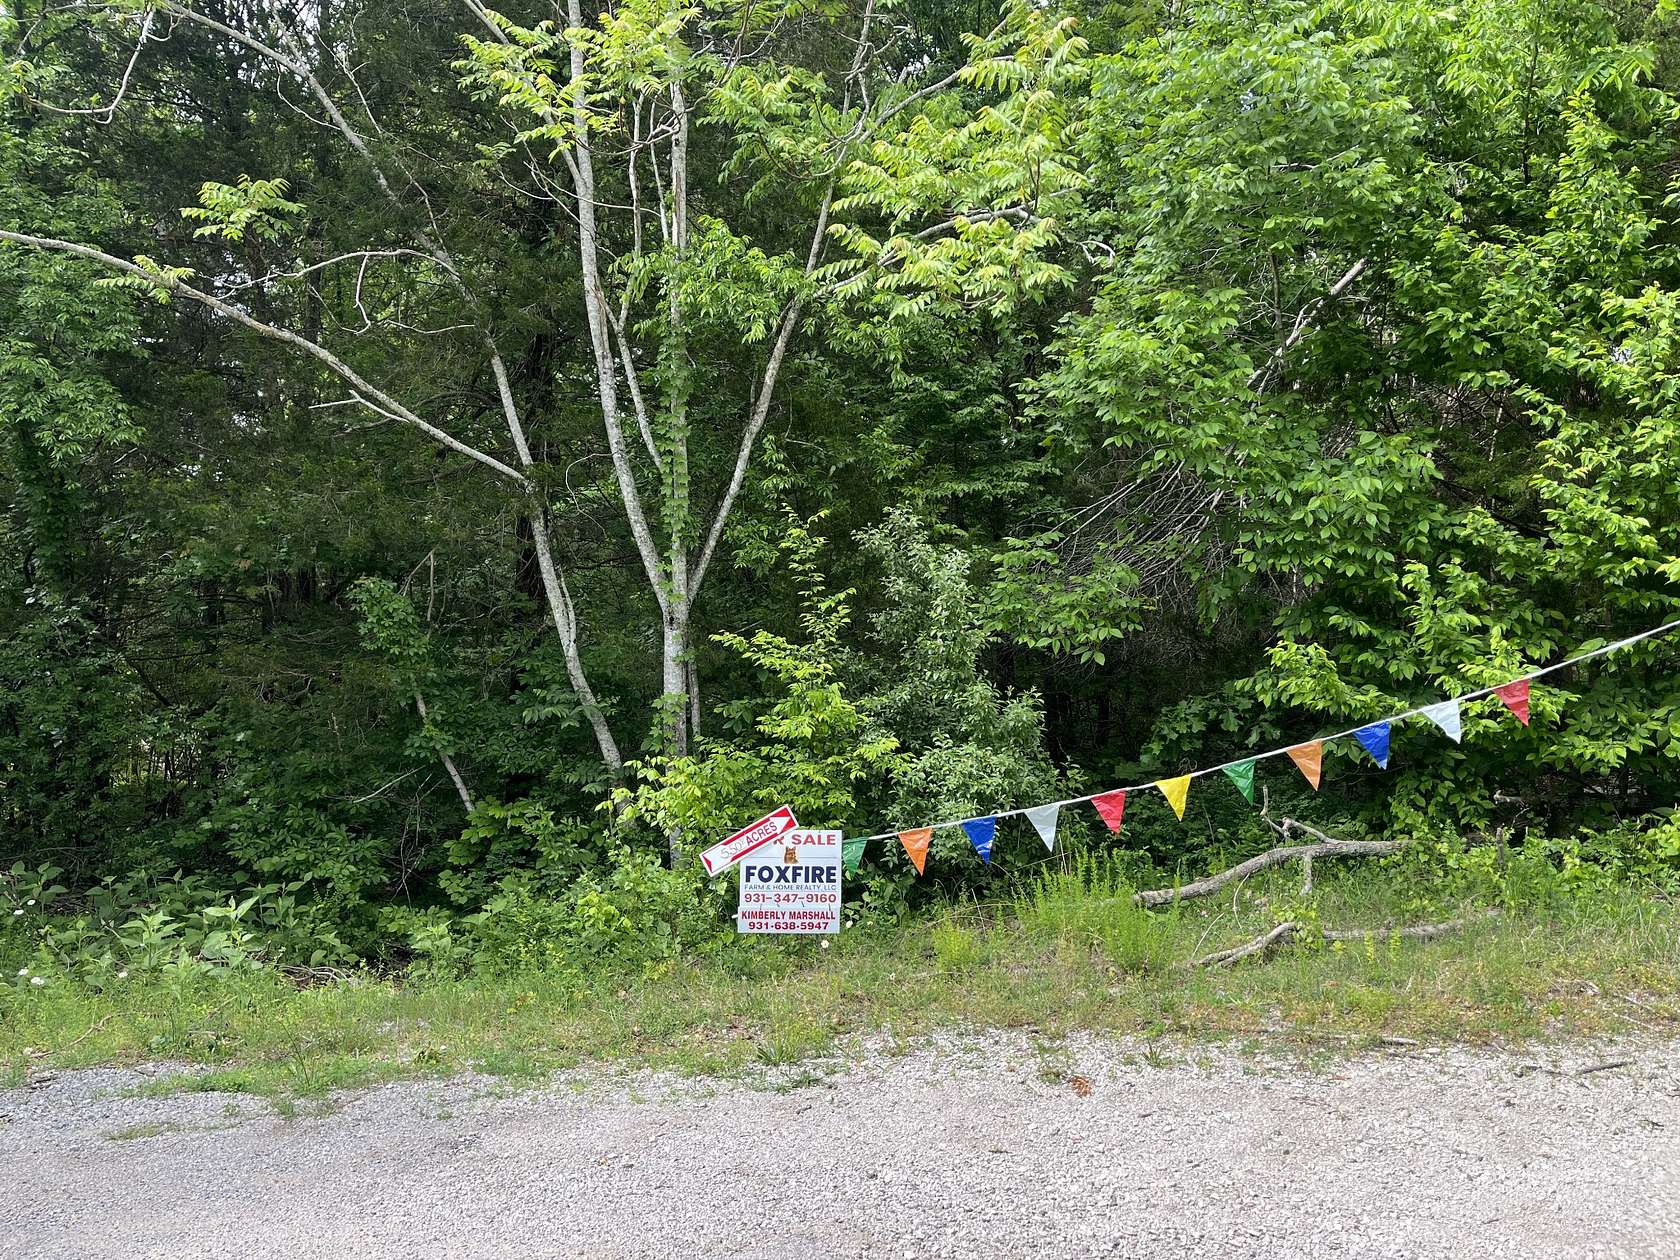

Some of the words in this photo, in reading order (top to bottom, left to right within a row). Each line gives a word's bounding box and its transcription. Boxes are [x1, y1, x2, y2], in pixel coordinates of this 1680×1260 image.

[746, 821, 778, 846] ACRES
[791, 834, 836, 846] SALE
[745, 865, 837, 883] FOXFIRE
[741, 911, 786, 920] KIMBERLY
[789, 911, 836, 920] MARSHALL
